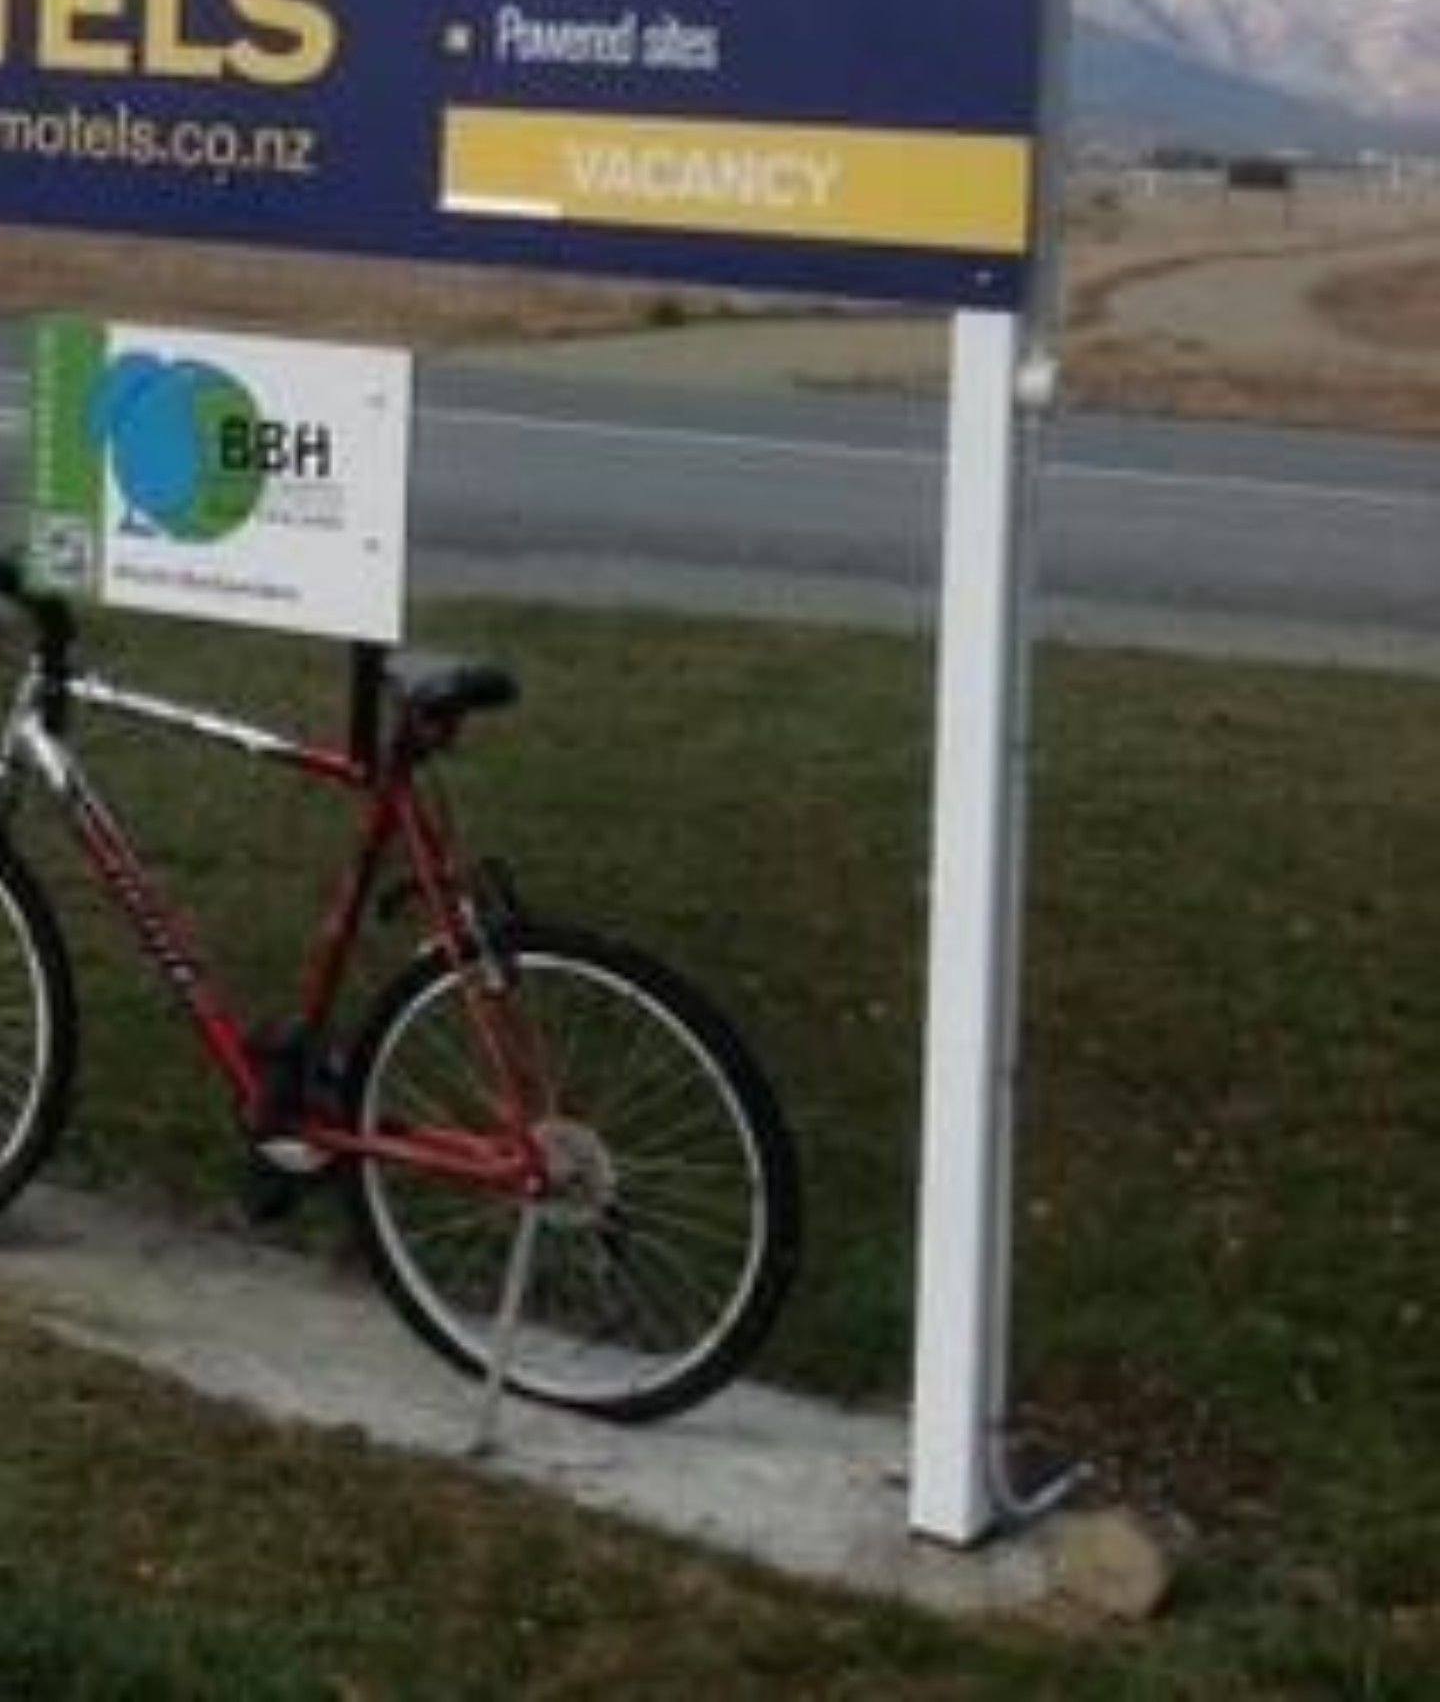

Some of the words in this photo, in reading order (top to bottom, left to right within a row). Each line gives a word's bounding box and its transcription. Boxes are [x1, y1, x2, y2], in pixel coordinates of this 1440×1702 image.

[495, 4, 637, 64] Powered
[641, 13, 720, 70] sites
[566, 138, 842, 206] VACANCY
[219, 414, 331, 478] BBH
